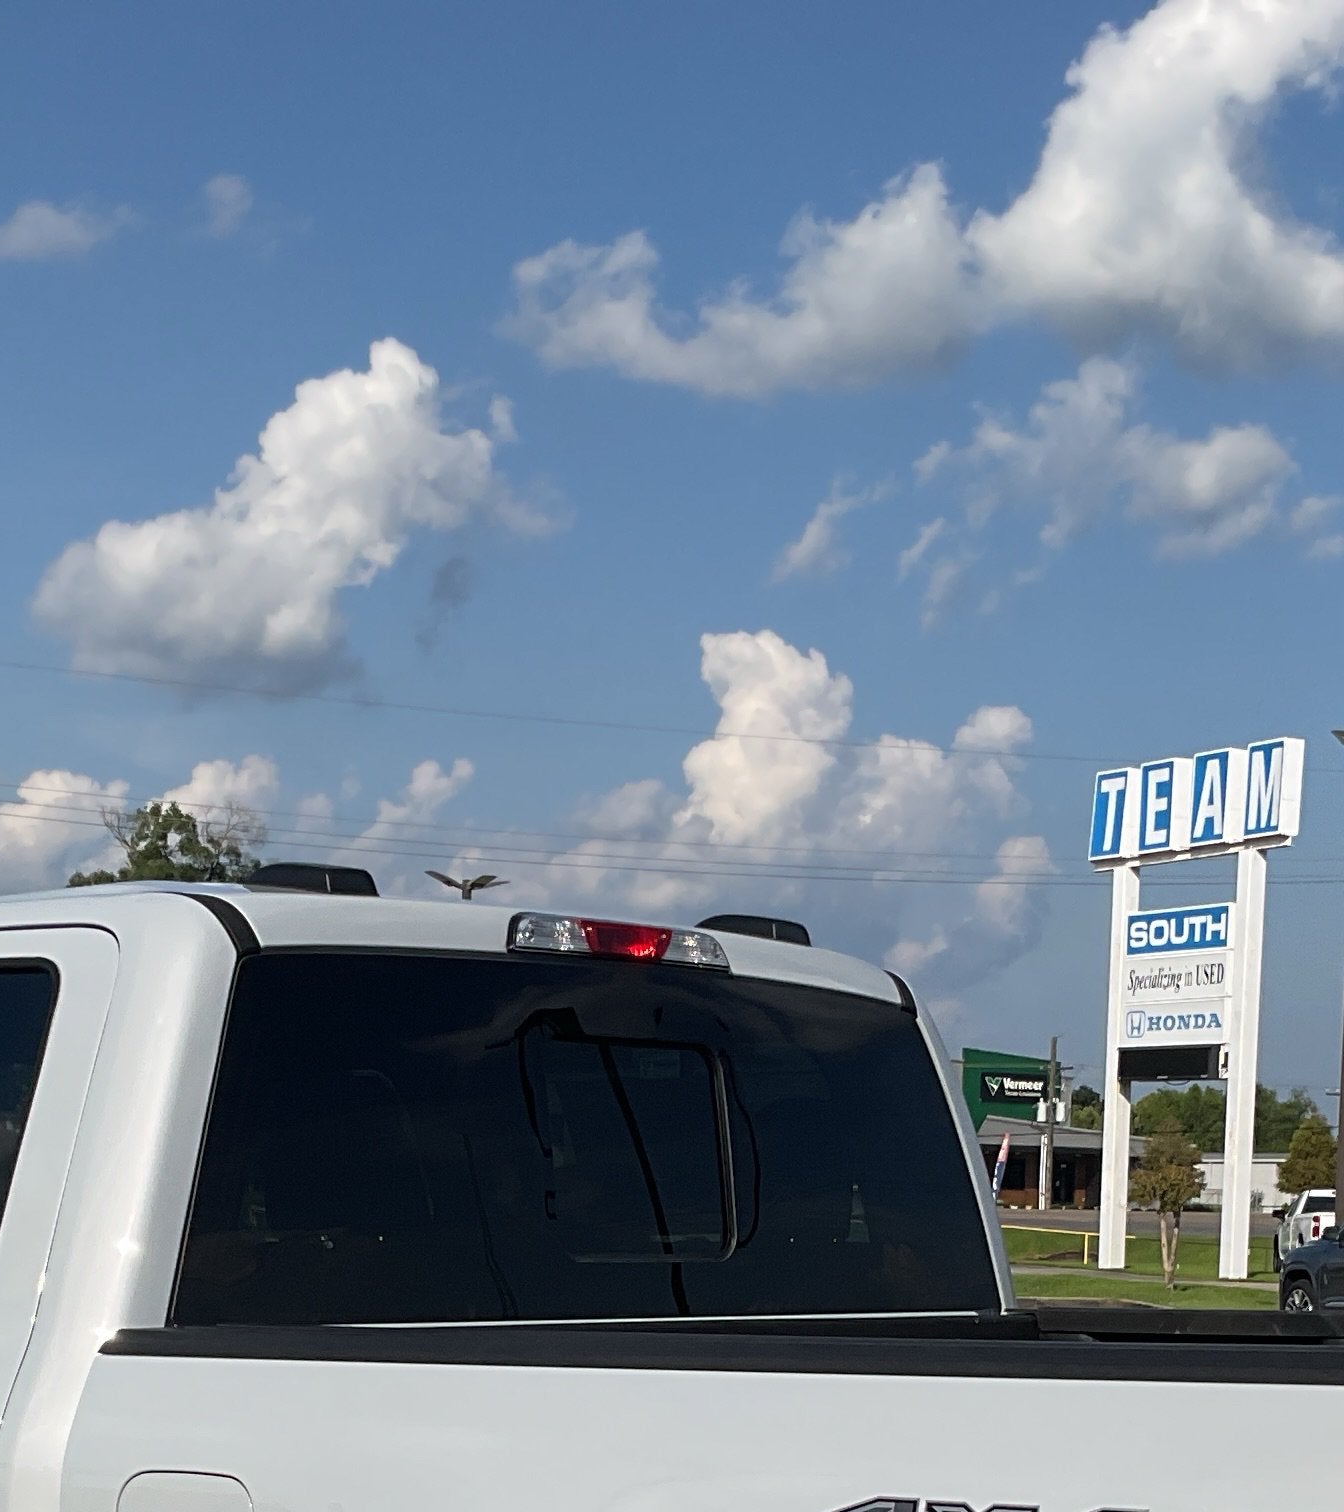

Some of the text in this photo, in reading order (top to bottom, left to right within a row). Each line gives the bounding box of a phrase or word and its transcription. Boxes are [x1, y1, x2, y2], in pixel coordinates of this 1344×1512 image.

[1100, 747, 1283, 851] TEAM
[1129, 912, 1226, 948] SOUTH
[1127, 962, 1224, 996] Specializing in USED
[1147, 1013, 1222, 1031] HONDA
[1003, 1077, 1044, 1090] Vermeer
